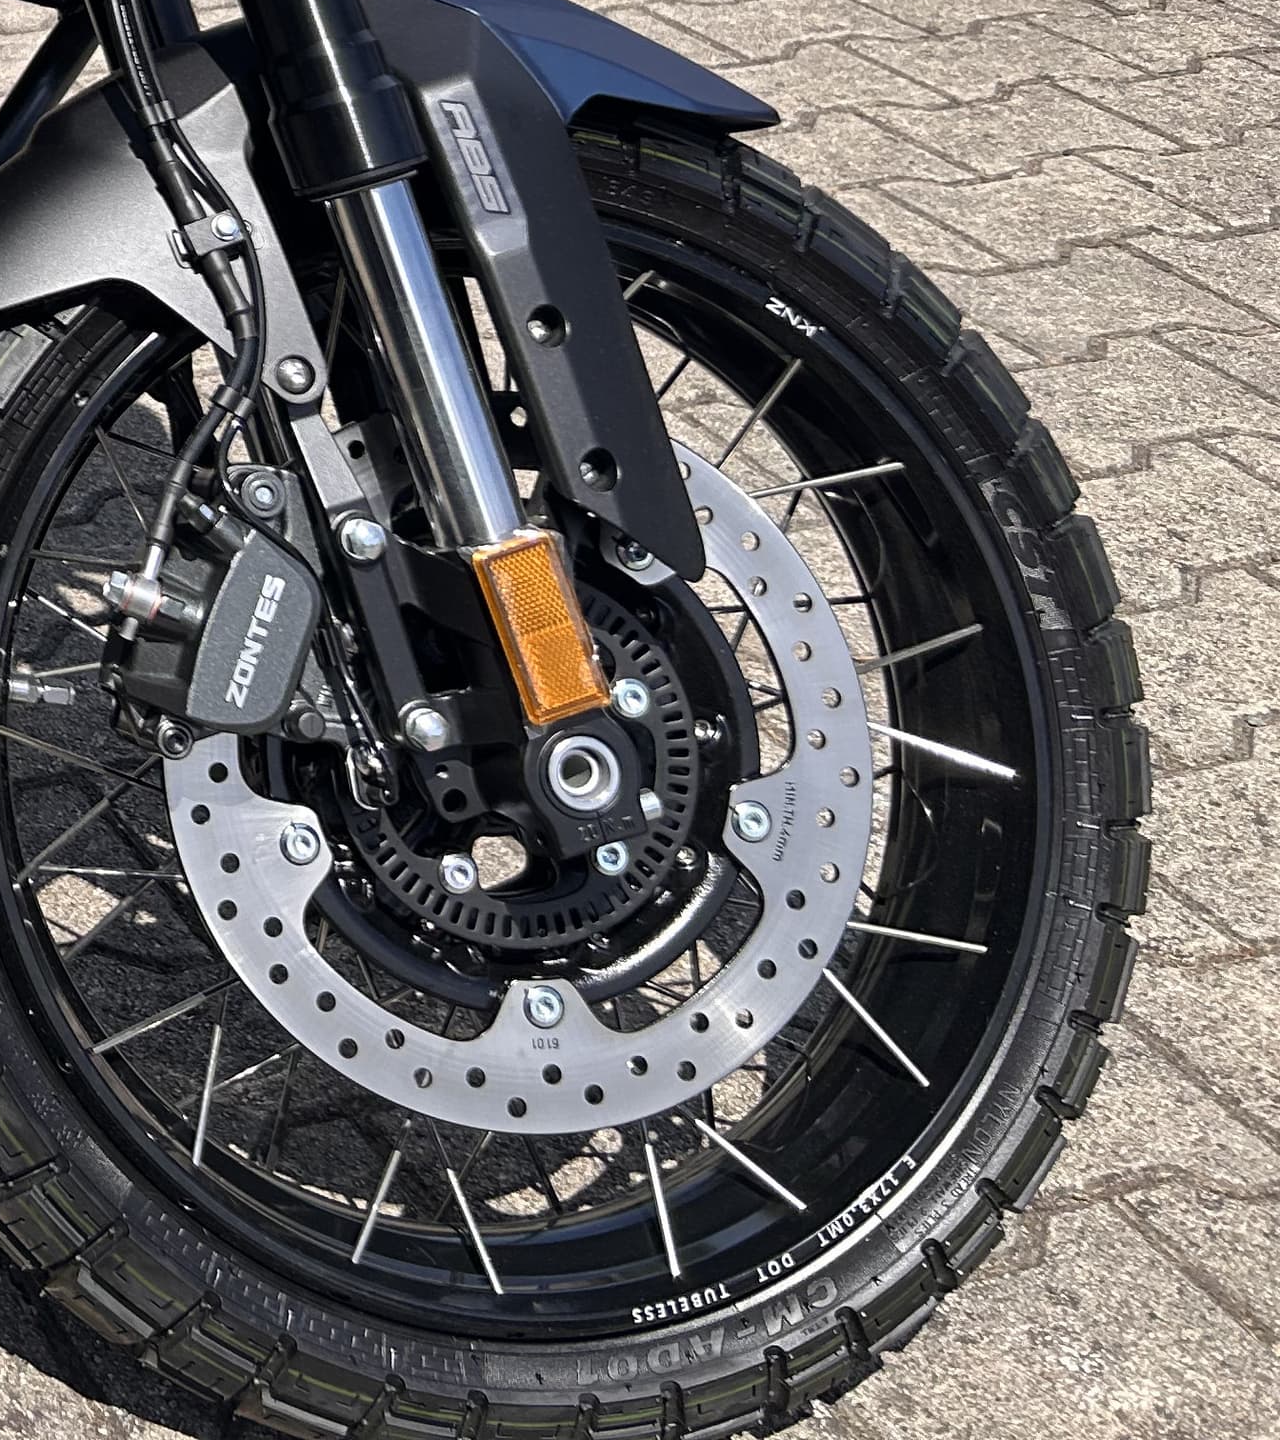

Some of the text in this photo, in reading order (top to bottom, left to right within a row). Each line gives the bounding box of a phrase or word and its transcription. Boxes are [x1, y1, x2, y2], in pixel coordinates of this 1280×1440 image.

[439, 101, 511, 214] ABS
[765, 296, 817, 338] ZNX
[224, 573, 287, 710] ZONTES
[902, 1154, 917, 1170] E
[756, 1252, 795, 1284] DOT
[631, 1281, 731, 1324] TUBELESS
